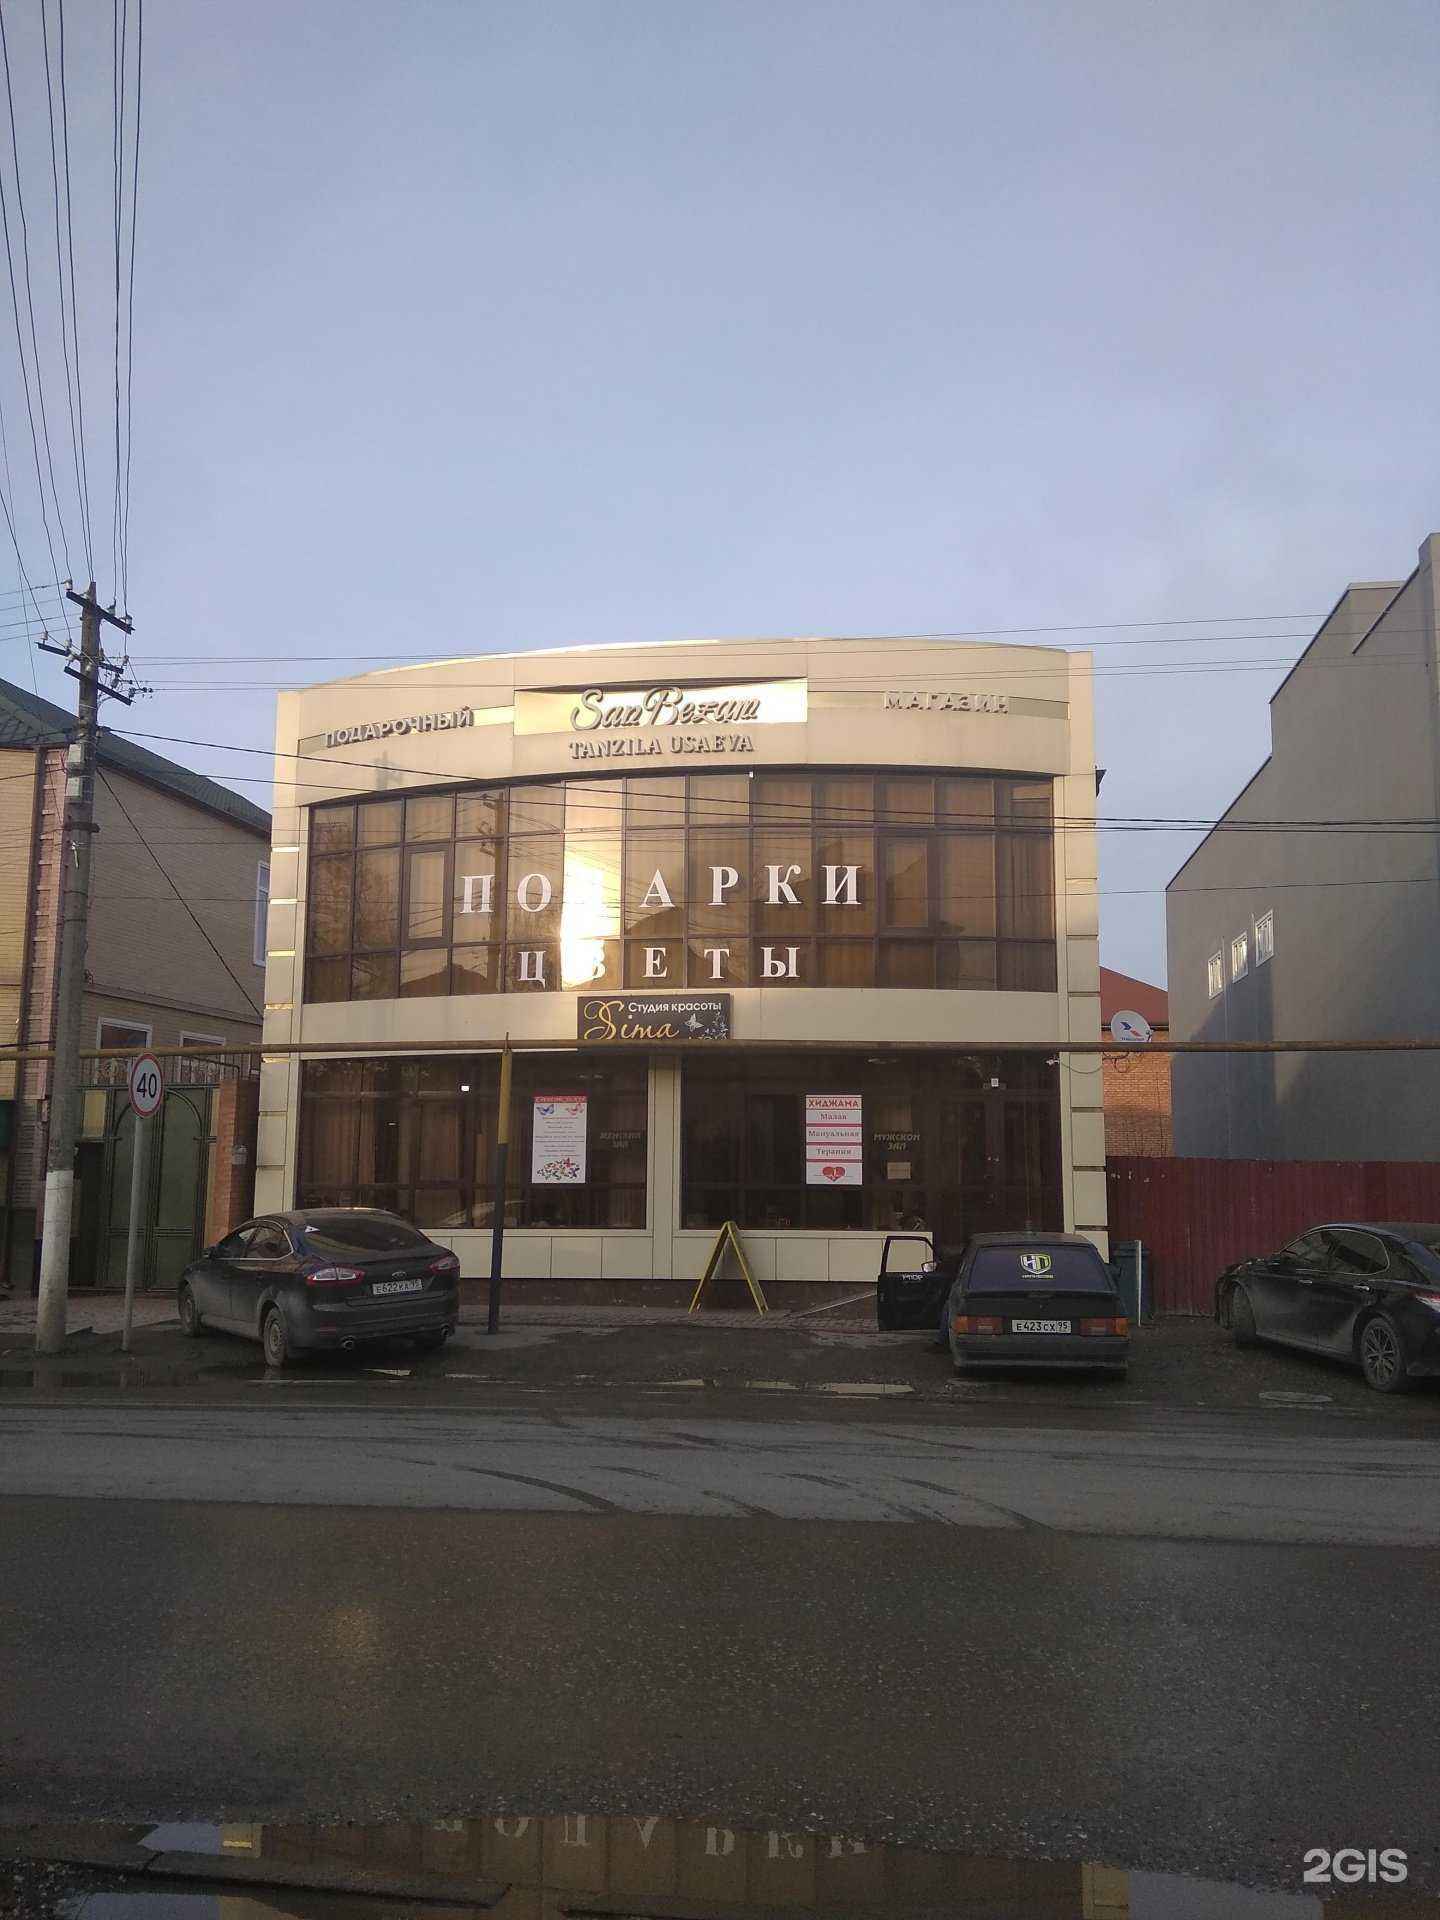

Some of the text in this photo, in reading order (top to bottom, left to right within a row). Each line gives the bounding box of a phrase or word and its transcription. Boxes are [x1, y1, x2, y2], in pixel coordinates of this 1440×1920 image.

[882, 691, 1010, 715] МАГАЗИН
[324, 706, 474, 748] ПОДАРОЧНЫЙ
[569, 733, 754, 760] TANZILA USAEVA
[460, 864, 862, 914] ПОАРКИ
[584, 1000, 680, 1041] Sima
[628, 1002, 722, 1014] Студия красоты
[136, 1072, 158, 1099] 40
